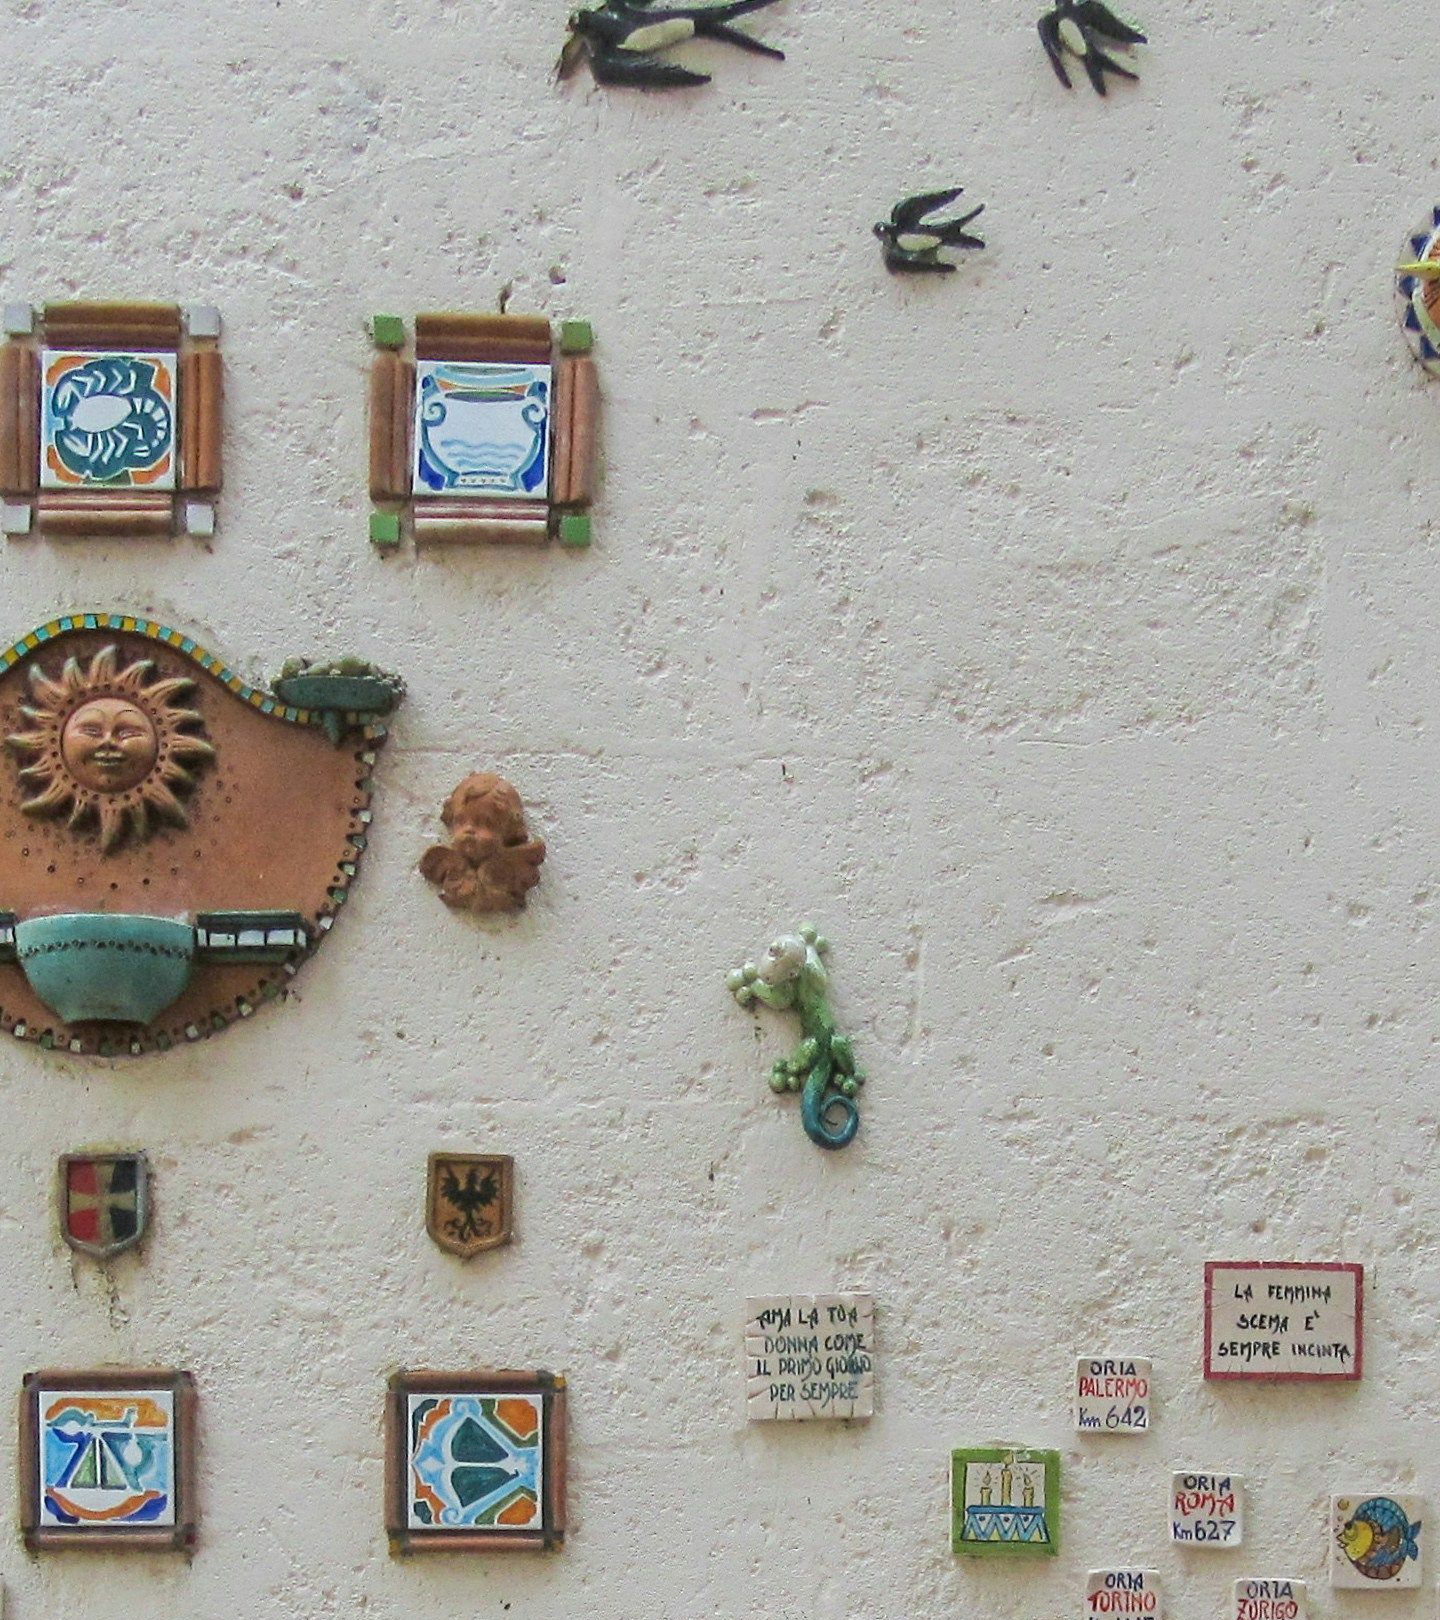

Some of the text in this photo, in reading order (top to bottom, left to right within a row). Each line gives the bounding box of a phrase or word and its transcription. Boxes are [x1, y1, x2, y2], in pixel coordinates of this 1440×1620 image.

[1235, 1284, 1331, 1302] LA FEMMINA
[757, 1310, 792, 1332] AMA
[799, 1311, 819, 1325] LA
[1237, 1314, 1288, 1333] SCEMA
[765, 1333, 865, 1356] DONNA COME
[1218, 1341, 1350, 1361] SEMPRE INCINTA
[756, 1361, 772, 1377] IL
[779, 1361, 821, 1380] PRIMO
[1090, 1361, 1136, 1376] ORIA
[770, 1382, 858, 1407] PER SEMPRE
[1079, 1378, 1148, 1397] PALERMO
[1184, 1476, 1231, 1495] ORIA
[1176, 1494, 1234, 1517] ROMA
[1105, 1572, 1143, 1590] ORIA
[1247, 1581, 1293, 1599] ORIA
[1088, 1590, 1156, 1613] TORINO
